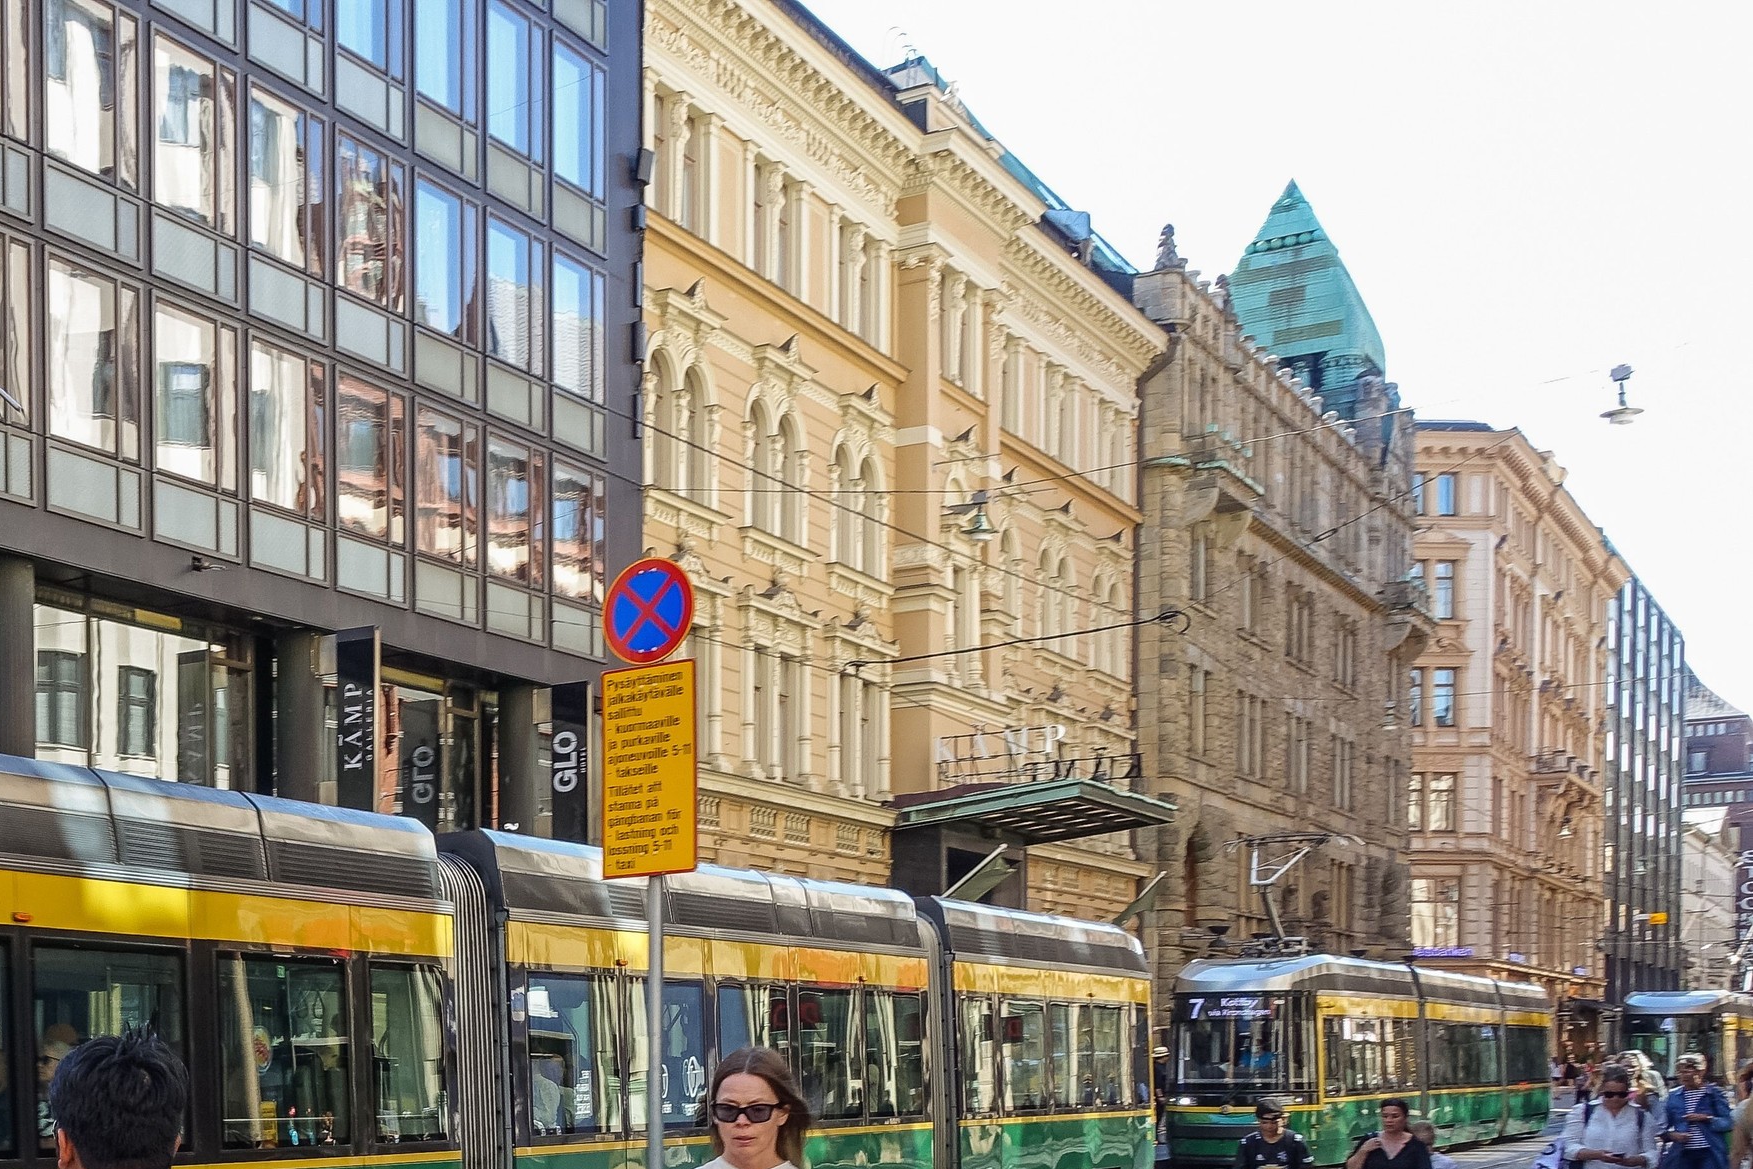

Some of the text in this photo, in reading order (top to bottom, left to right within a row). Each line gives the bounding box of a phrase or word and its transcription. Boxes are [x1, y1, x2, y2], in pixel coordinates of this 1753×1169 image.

[606, 671, 683, 691] Pysäyttäminen
[606, 685, 684, 707] jalkakäytävälle
[607, 706, 643, 720] sallittu
[338, 683, 363, 772] KÄMP
[365, 689, 373, 762] GALLERIA
[615, 715, 680, 734] kuormaaville
[607, 732, 671, 752] ja purkaville
[552, 731, 578, 793] GLO
[607, 747, 669, 766] ajoneuvoille
[615, 763, 659, 778] takseille
[607, 781, 662, 797] Tillåtet att
[607, 796, 659, 812] stanna på
[607, 808, 682, 829] gångbanan för
[615, 827, 656, 841] lastning
[659, 824, 679, 837] och
[607, 843, 649, 857] lossning
[615, 857, 635, 870] taxi
[1188, 998, 1206, 1020] 7
